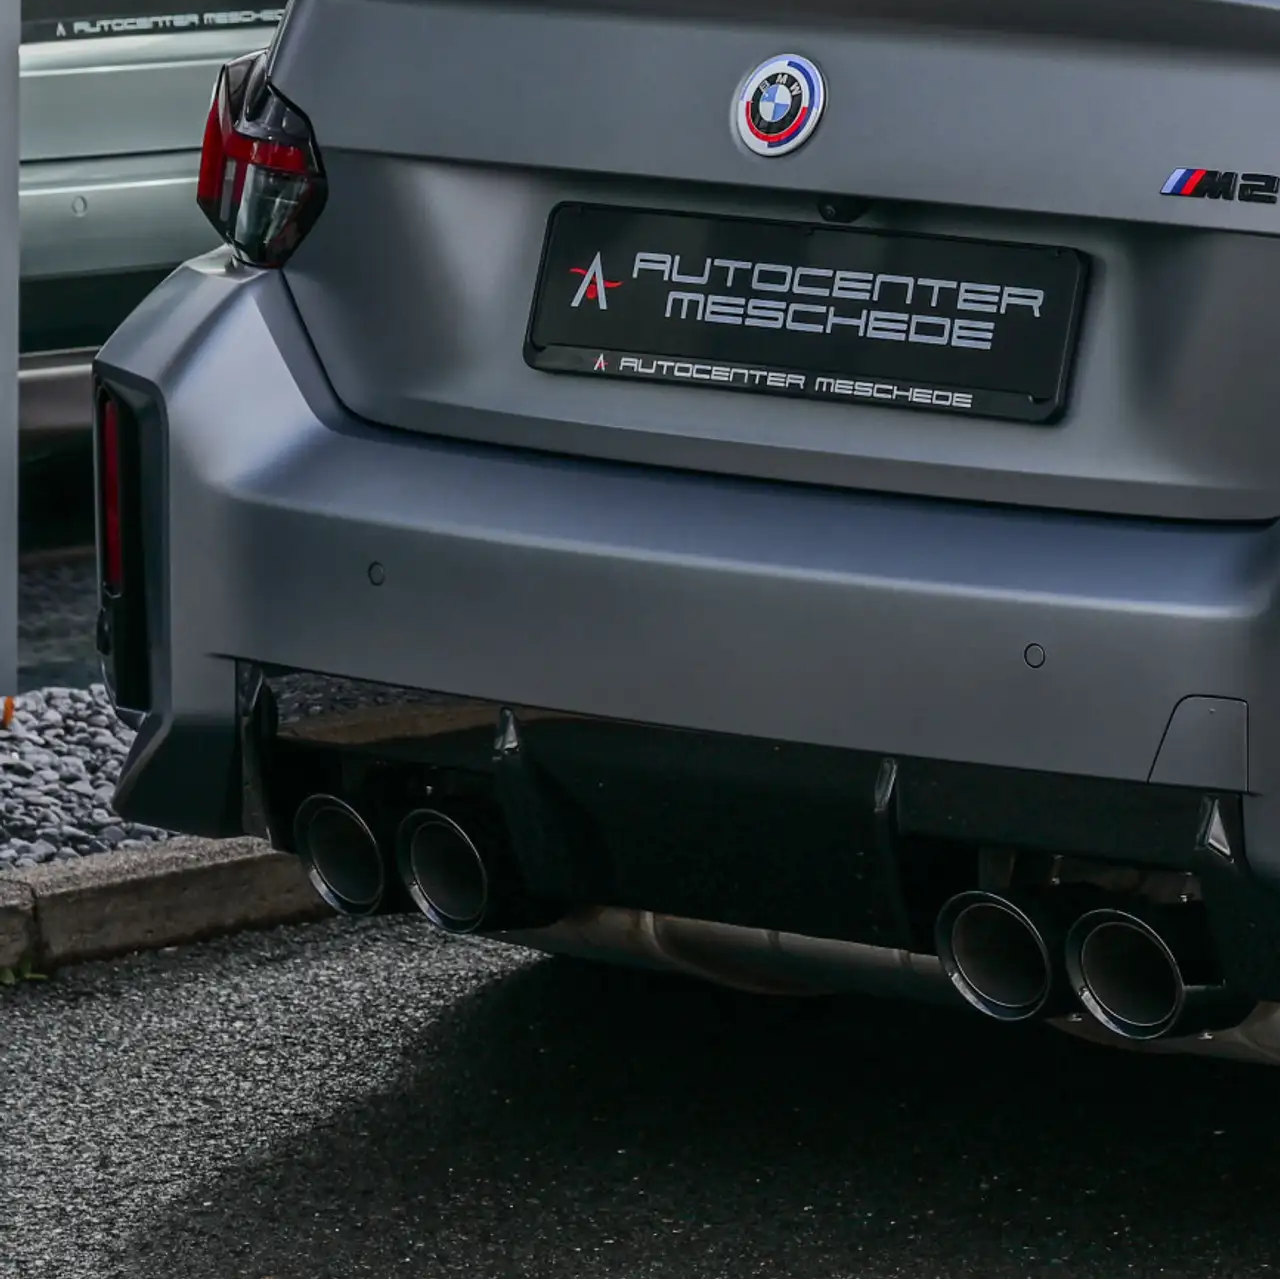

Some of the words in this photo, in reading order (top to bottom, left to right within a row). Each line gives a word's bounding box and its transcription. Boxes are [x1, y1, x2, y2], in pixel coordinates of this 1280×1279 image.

[73, 14, 199, 35] AUTOCENTER
[203, 8, 285, 25] MESCHED
[758, 73, 803, 97] BMW
[1185, 170, 1280, 204] M2
[632, 252, 1045, 317] AUTOCENTER
[664, 290, 995, 350] MESCHEDE
[619, 357, 805, 390] AUTOCENTER
[815, 376, 972, 408] MESCHEDE
